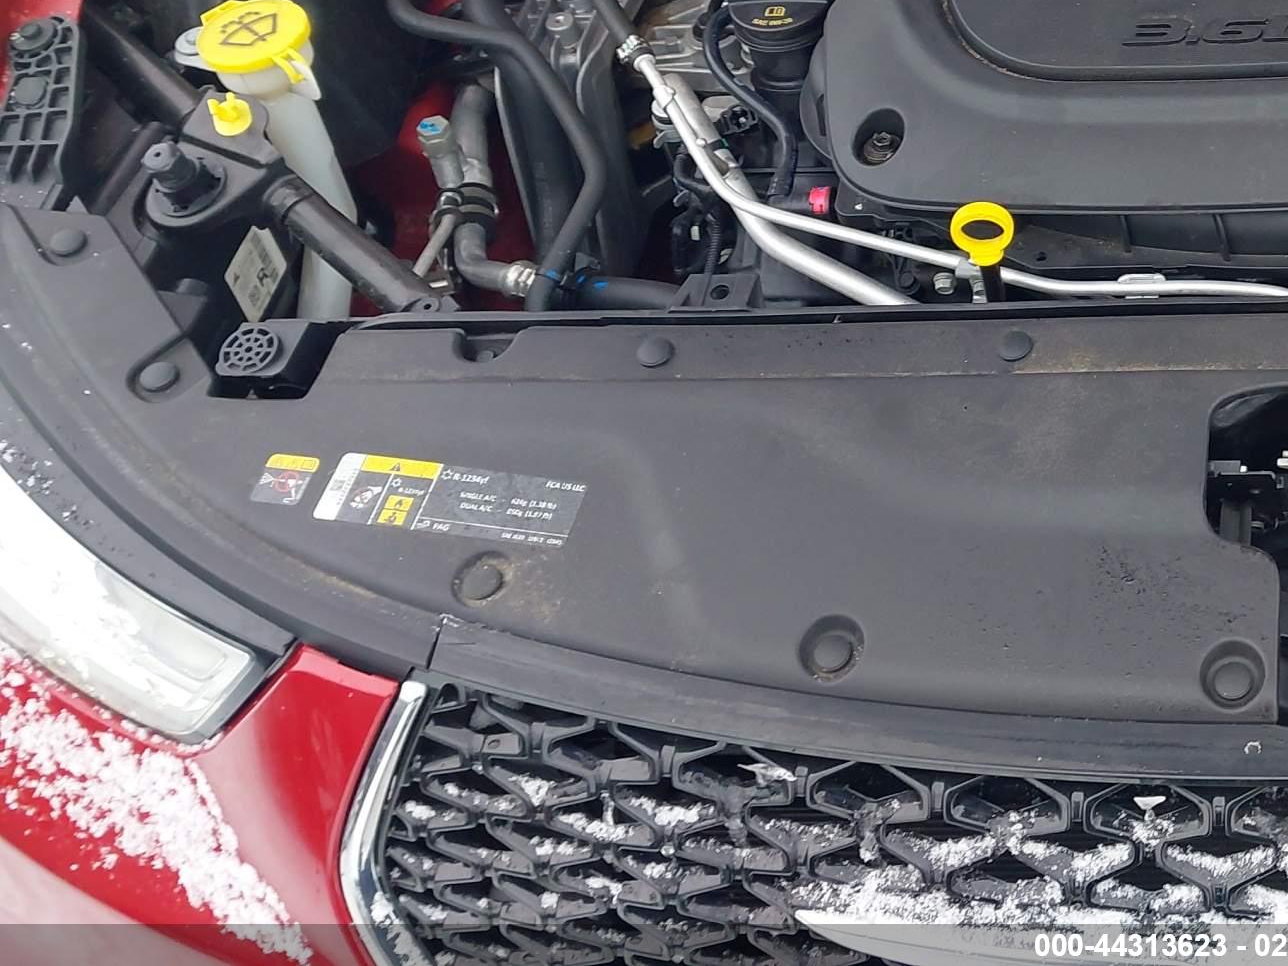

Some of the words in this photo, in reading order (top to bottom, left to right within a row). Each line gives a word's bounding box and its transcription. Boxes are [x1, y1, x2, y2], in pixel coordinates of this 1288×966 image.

[452, 472, 489, 485] R-1234yf
[545, 481, 560, 489] FCA
[561, 482, 572, 490] US
[572, 484, 587, 492] LLC
[432, 522, 450, 531] PAG
